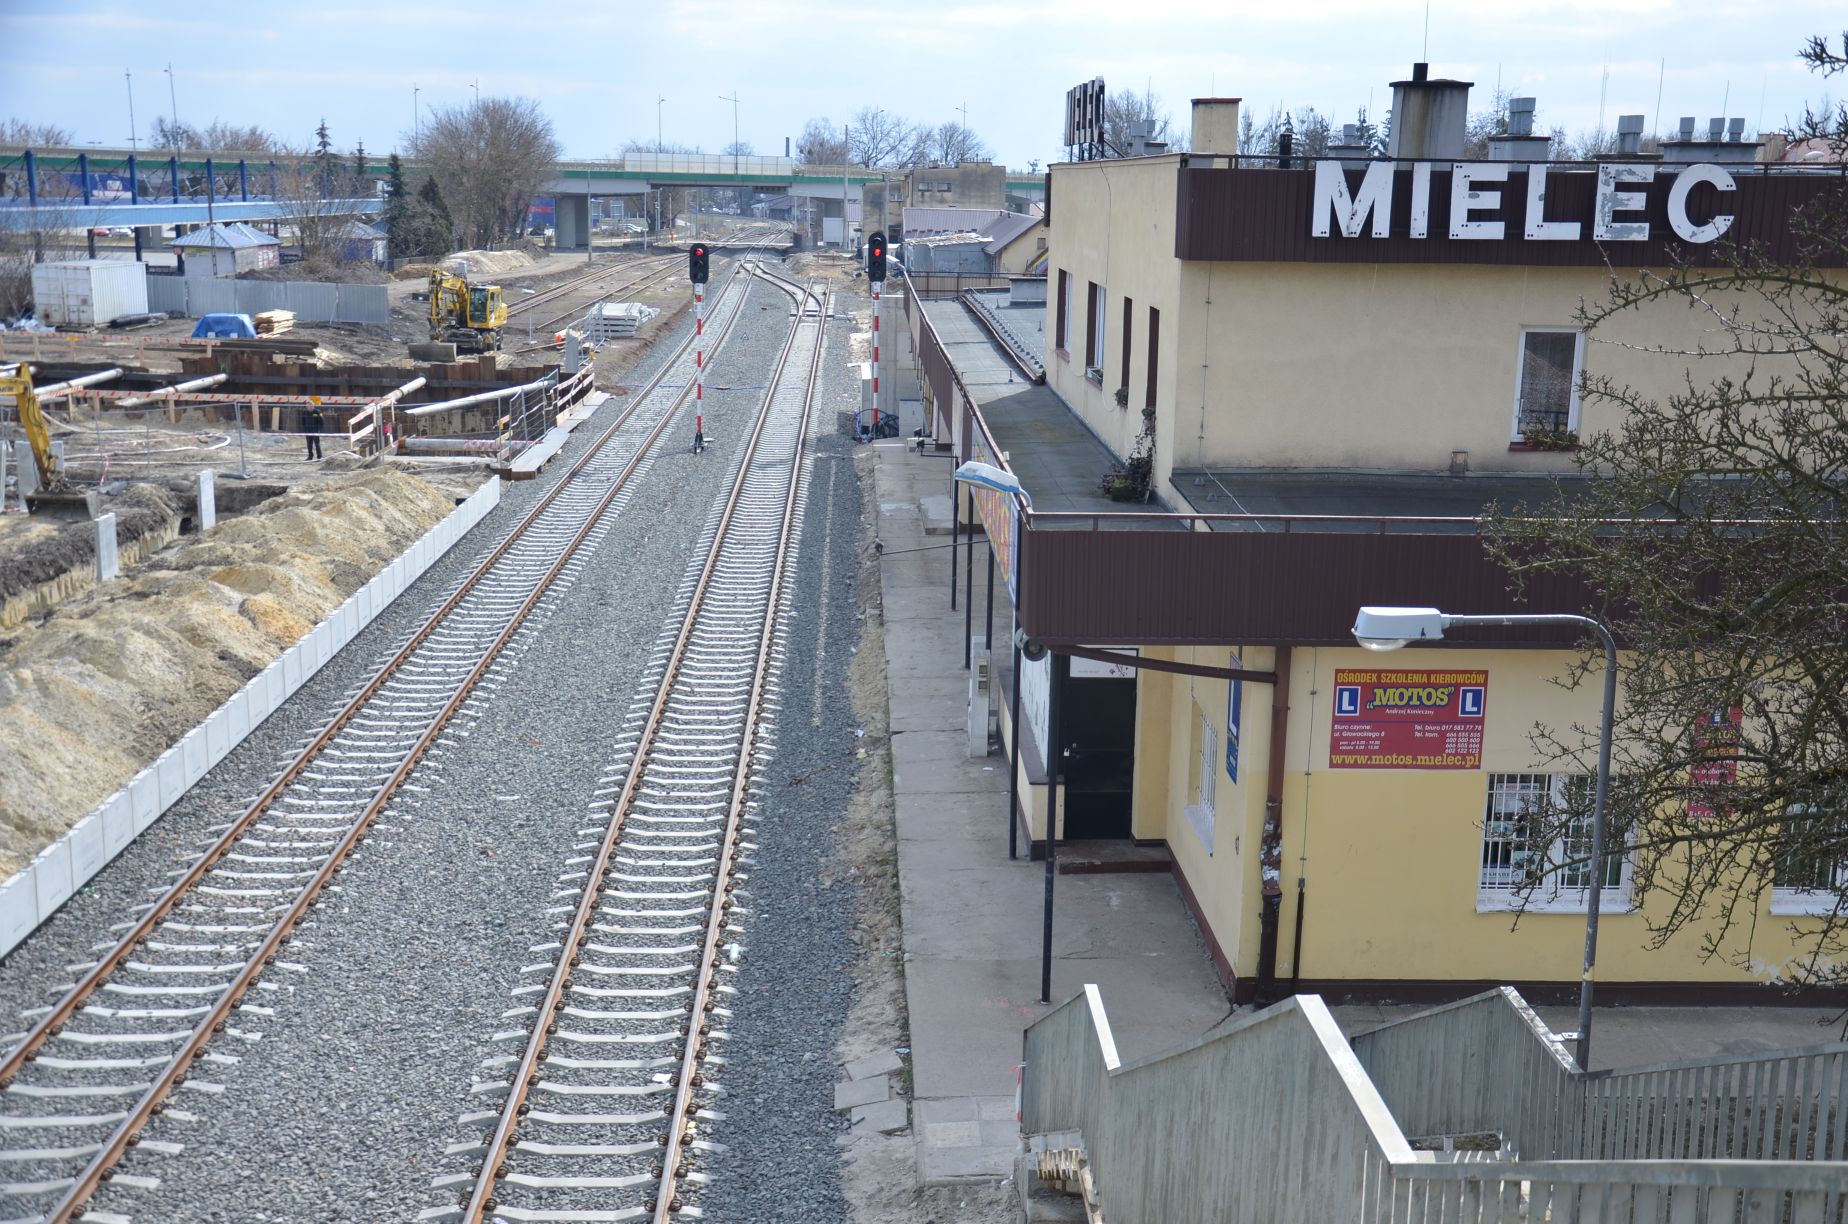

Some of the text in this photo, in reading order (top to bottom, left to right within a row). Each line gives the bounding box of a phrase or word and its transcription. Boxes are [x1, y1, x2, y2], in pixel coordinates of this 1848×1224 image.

[1312, 160, 1737, 243] MIELEC
[1337, 671, 1485, 684] OŚRODEK SZKOLENIA KIEROWCÓW
[1342, 691, 1354, 711] L
[1465, 692, 1478, 712] L
